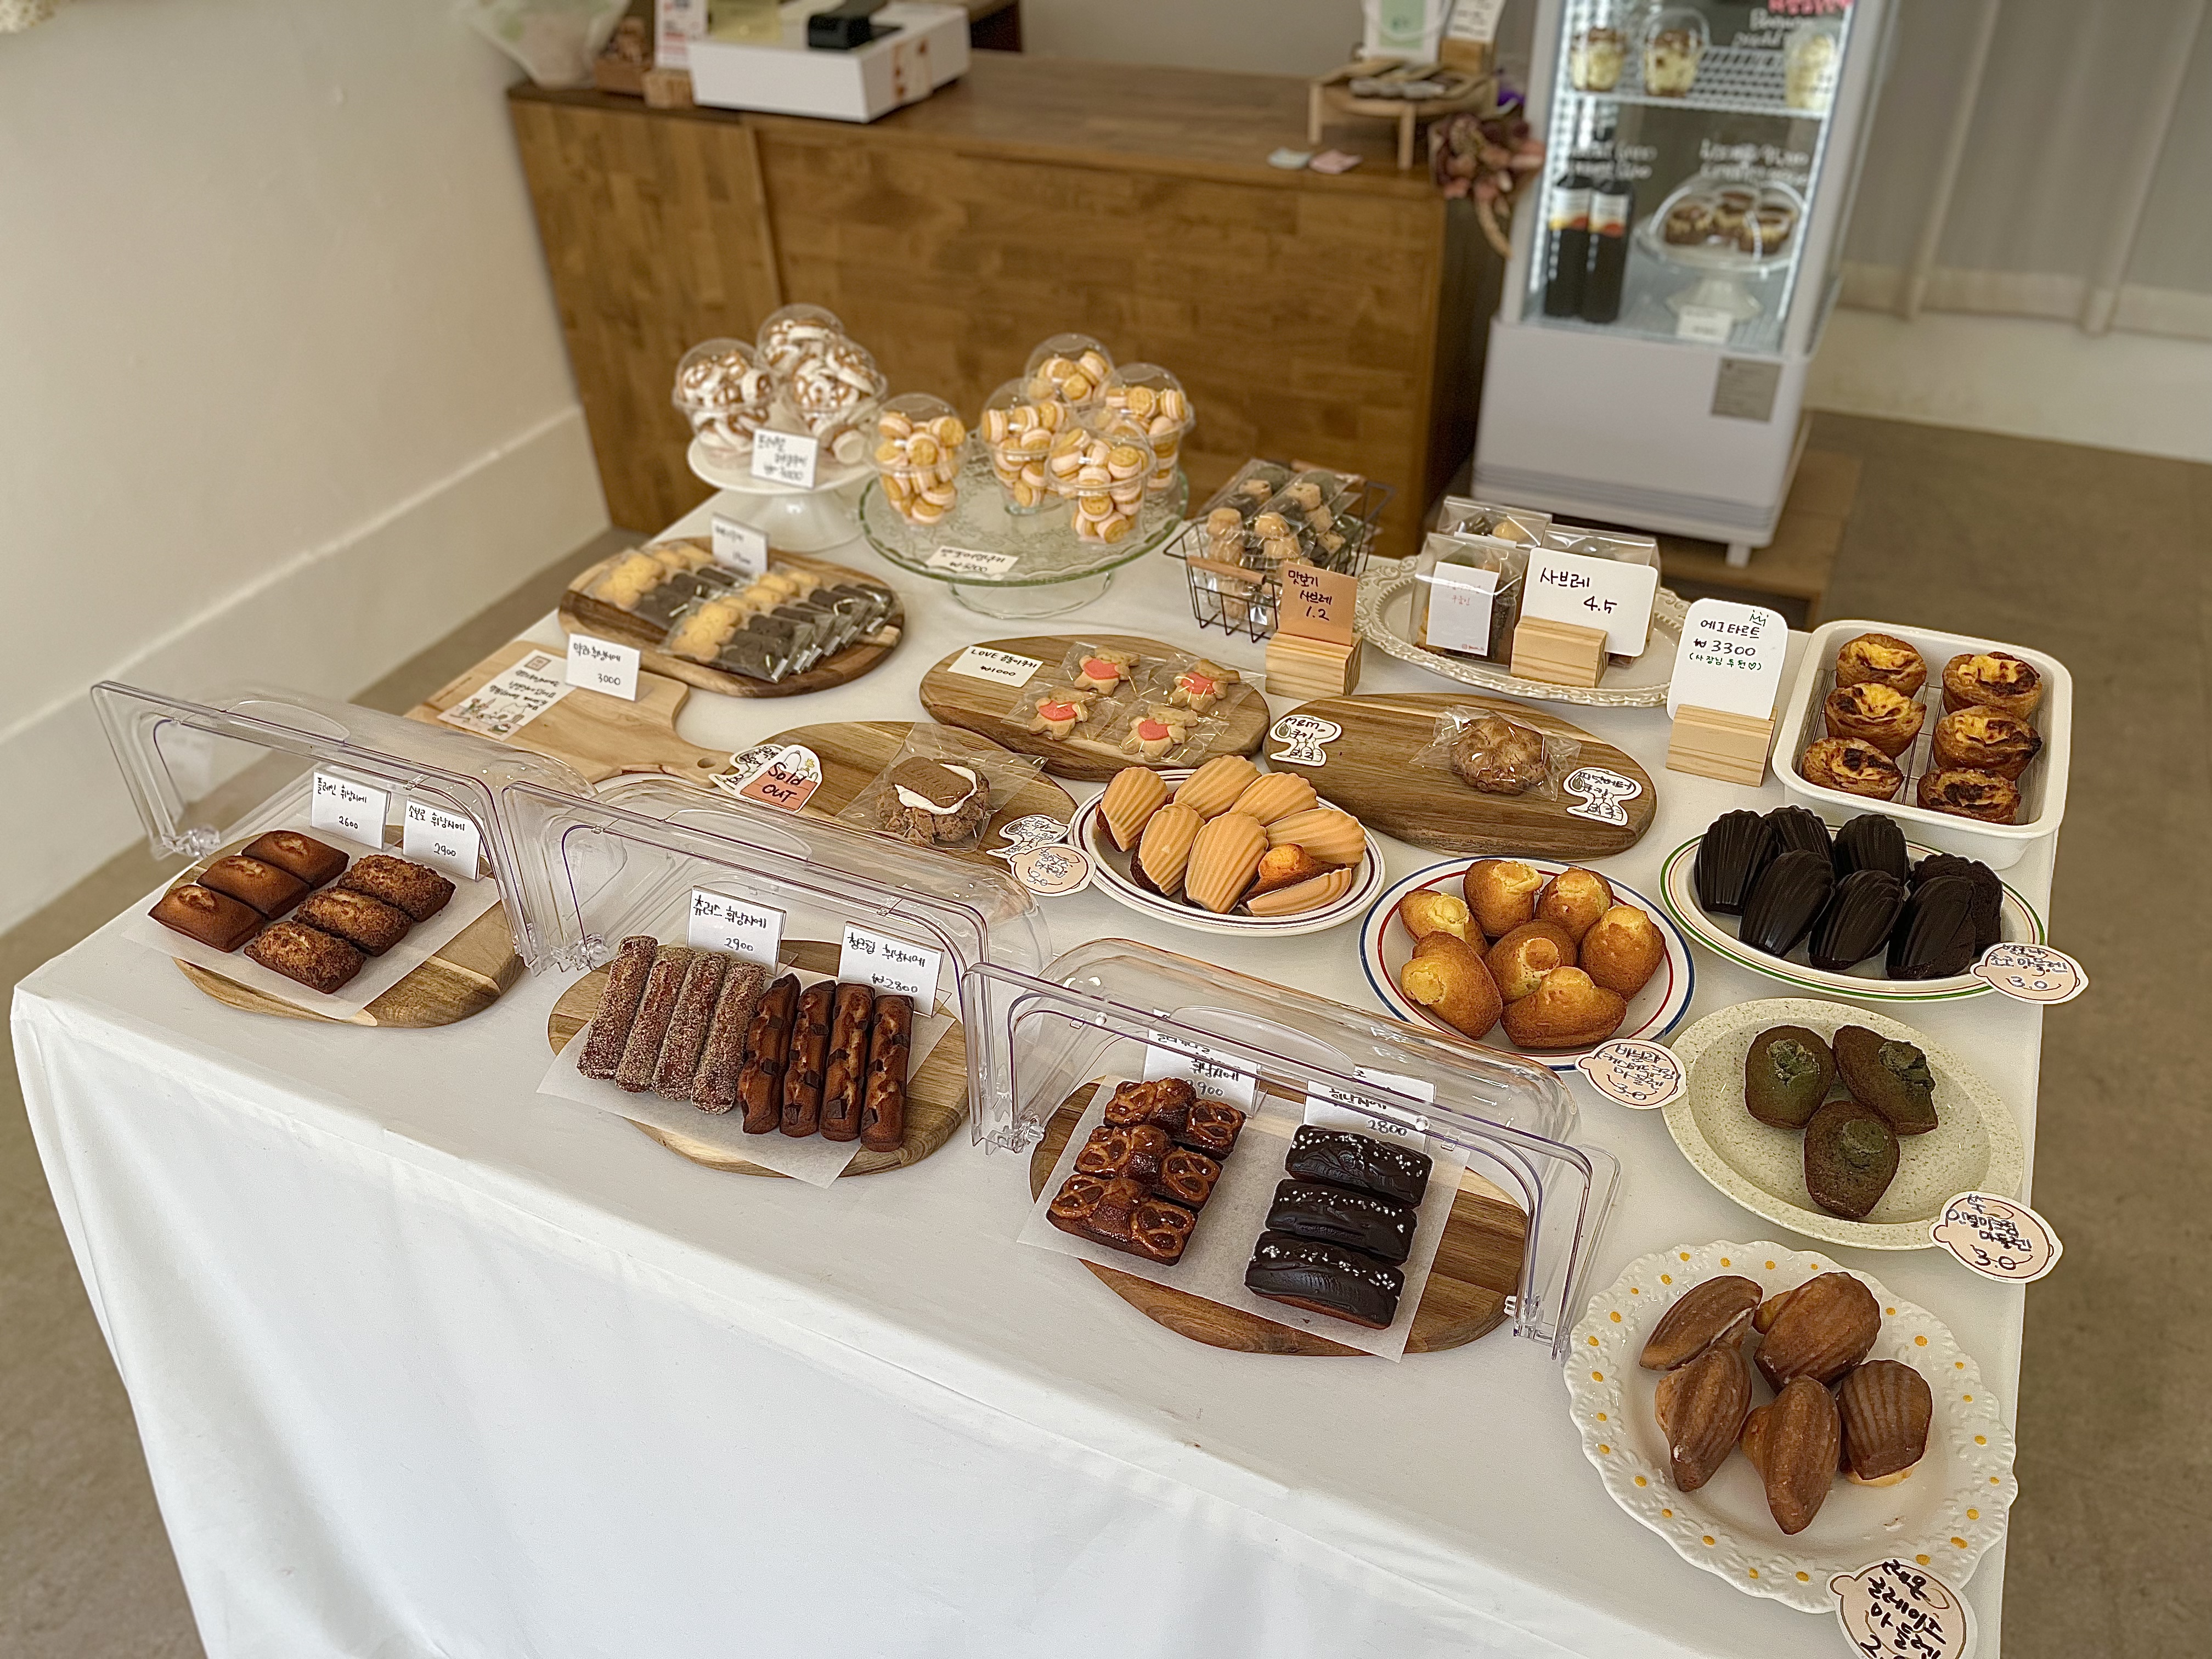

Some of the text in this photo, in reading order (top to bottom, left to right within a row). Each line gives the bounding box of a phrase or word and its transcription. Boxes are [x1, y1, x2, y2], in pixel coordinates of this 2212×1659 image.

[1288, 570, 1319, 588] 맛보기
[1540, 567, 1590, 589] 사브레
[1300, 590, 1333, 606] 사브레
[1583, 596, 1617, 614] 4.5
[1306, 606, 1330, 621] 1.2
[1700, 619, 1760, 639] 에그타르트
[971, 649, 998, 659] LOVE
[597, 673, 621, 685] 3000
[768, 761, 807, 786] Sold
[317, 777, 367, 803] 플레인 휘낭시에
[338, 816, 358, 829] 2600
[409, 805, 465, 831] 소보로 휘낭시에
[433, 843, 456, 856] 2900
[693, 895, 766, 929] 츄러스 휘낭시에
[724, 938, 753, 951] 2900
[882, 944, 926, 967] 휘낭시에
[1365, 1119, 1408, 1136] 2800
[1974, 1248, 2016, 1271] 3.0
